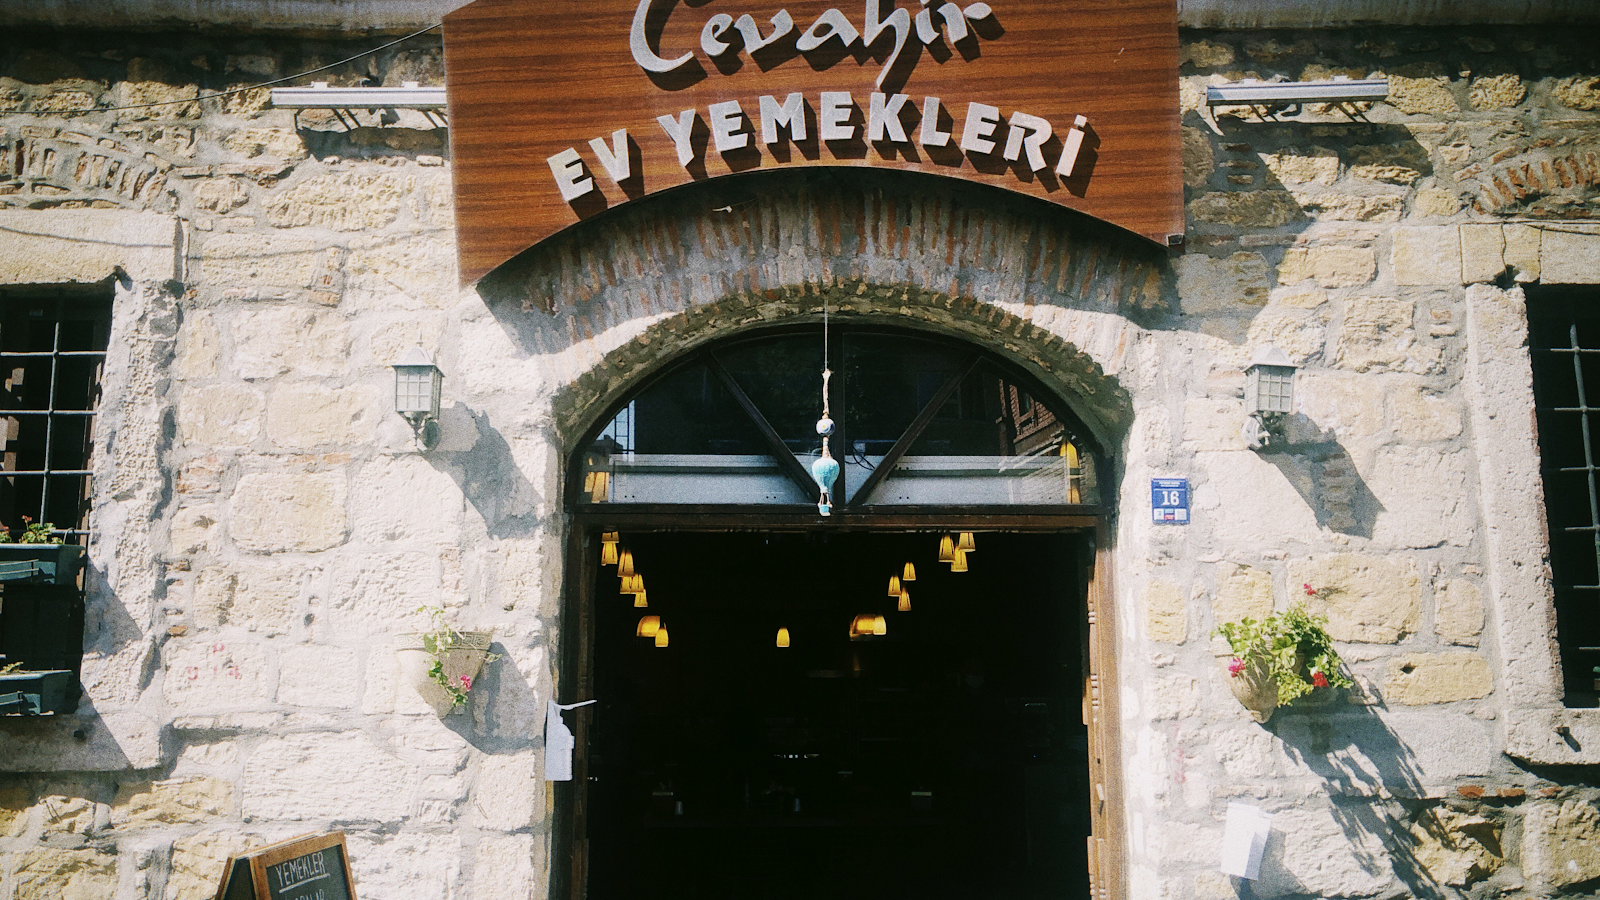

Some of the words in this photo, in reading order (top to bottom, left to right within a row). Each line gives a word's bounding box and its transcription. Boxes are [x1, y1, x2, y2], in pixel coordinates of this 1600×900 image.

[630, 0, 993, 89] Cevahir
[546, 128, 631, 203] EV
[1161, 490, 1180, 506] 16
[275, 852, 326, 887] YEMEKLER
